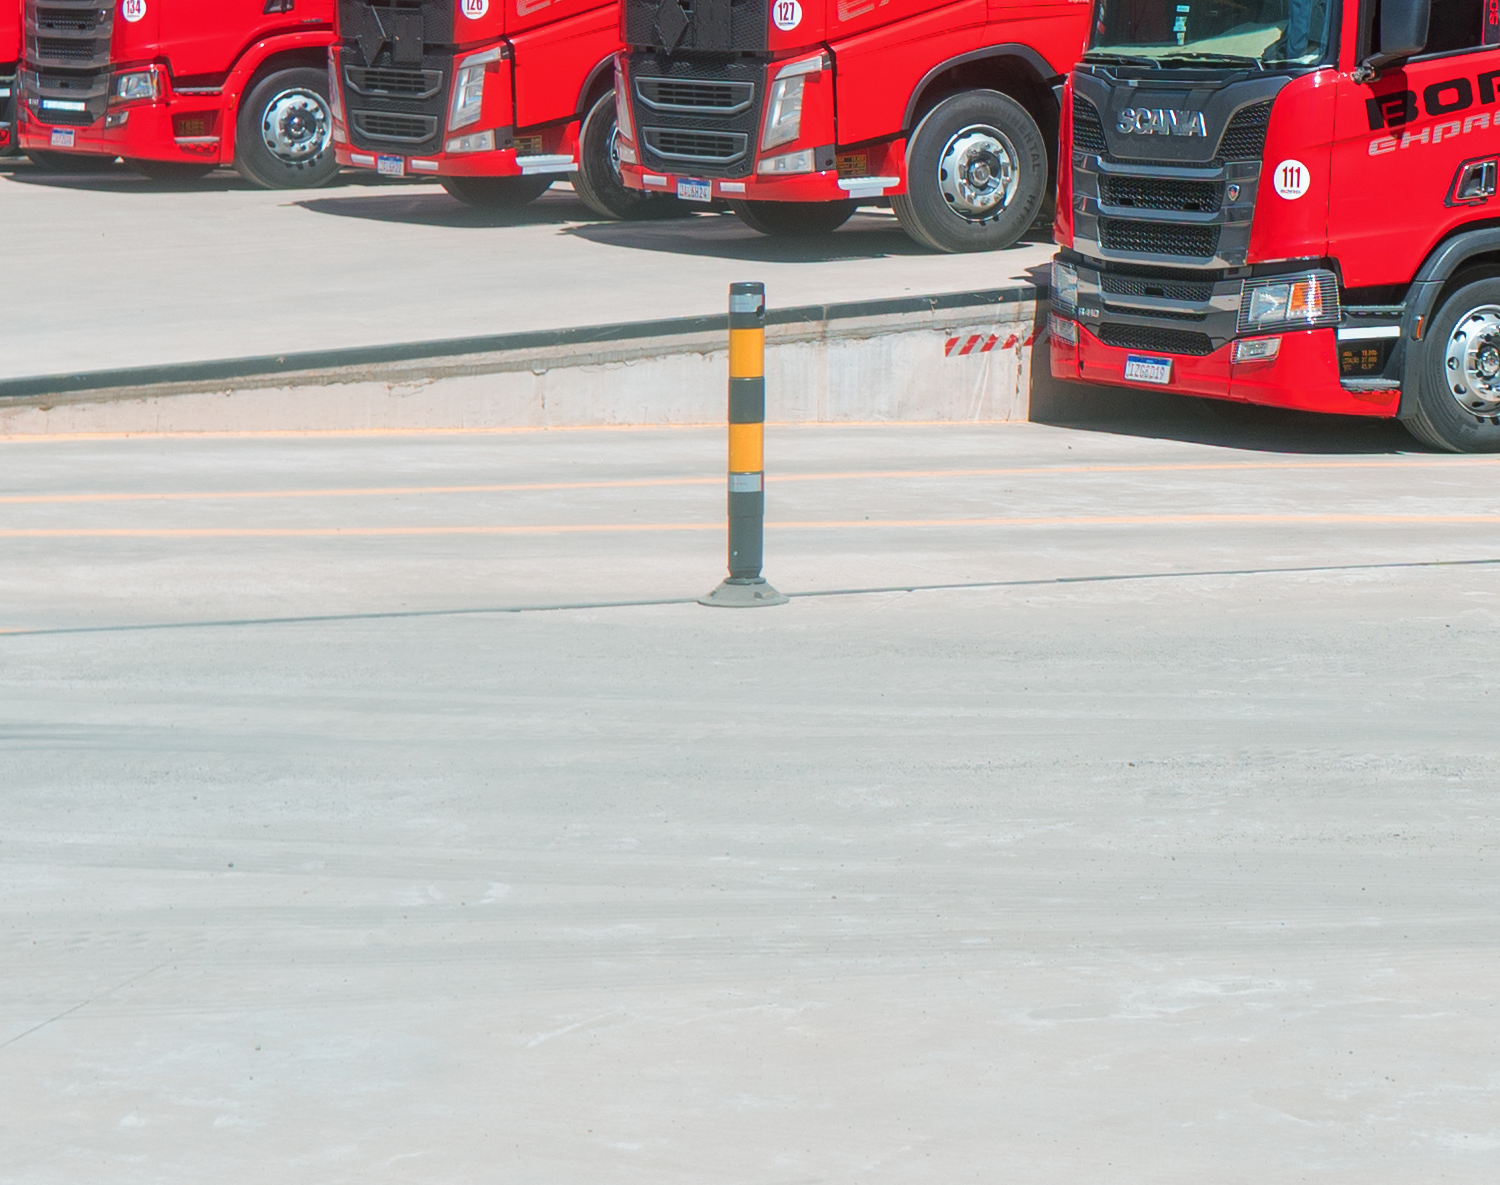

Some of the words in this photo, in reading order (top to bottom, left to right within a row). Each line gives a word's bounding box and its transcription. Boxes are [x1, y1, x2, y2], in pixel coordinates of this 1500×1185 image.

[126, 0, 141, 14] 134
[778, 2, 795, 21] 127
[1116, 107, 1208, 138] SCANIA
[1282, 166, 1302, 189] 111
